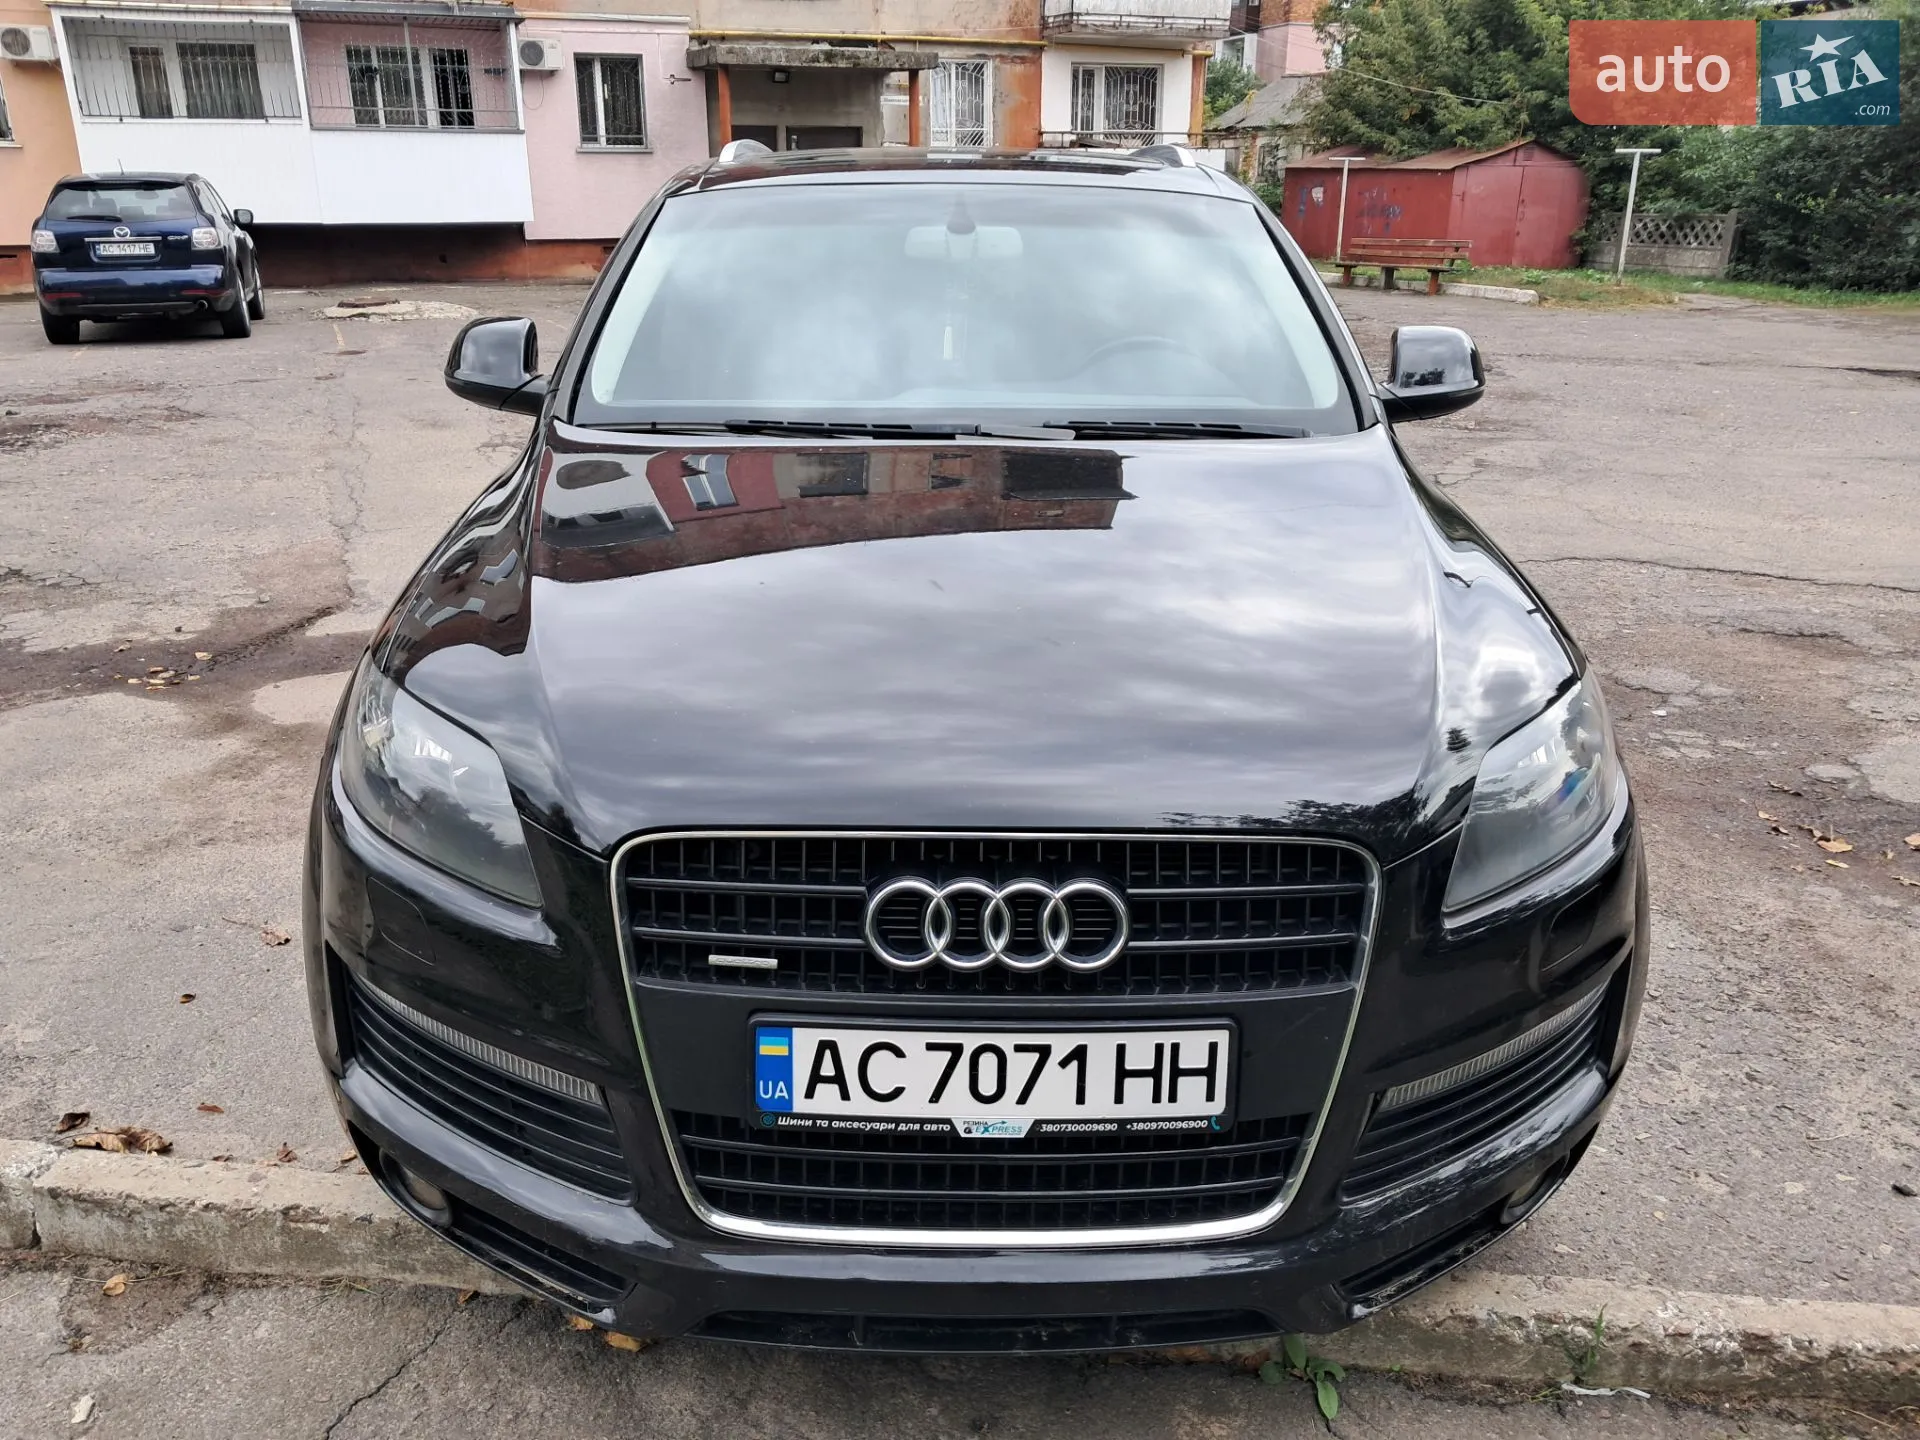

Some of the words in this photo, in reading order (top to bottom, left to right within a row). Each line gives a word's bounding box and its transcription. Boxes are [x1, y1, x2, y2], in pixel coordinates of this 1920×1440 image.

[804, 1039, 907, 1103] AC
[925, 1042, 1088, 1105] 7071
[1114, 1040, 1218, 1104] HH
[759, 1080, 789, 1100] UA
[777, 1115, 813, 1127] Шини
[815, 1119, 828, 1128] та
[831, 1120, 896, 1132] аксесуари
[898, 1121, 920, 1131] для
[923, 1123, 951, 1132] авто
